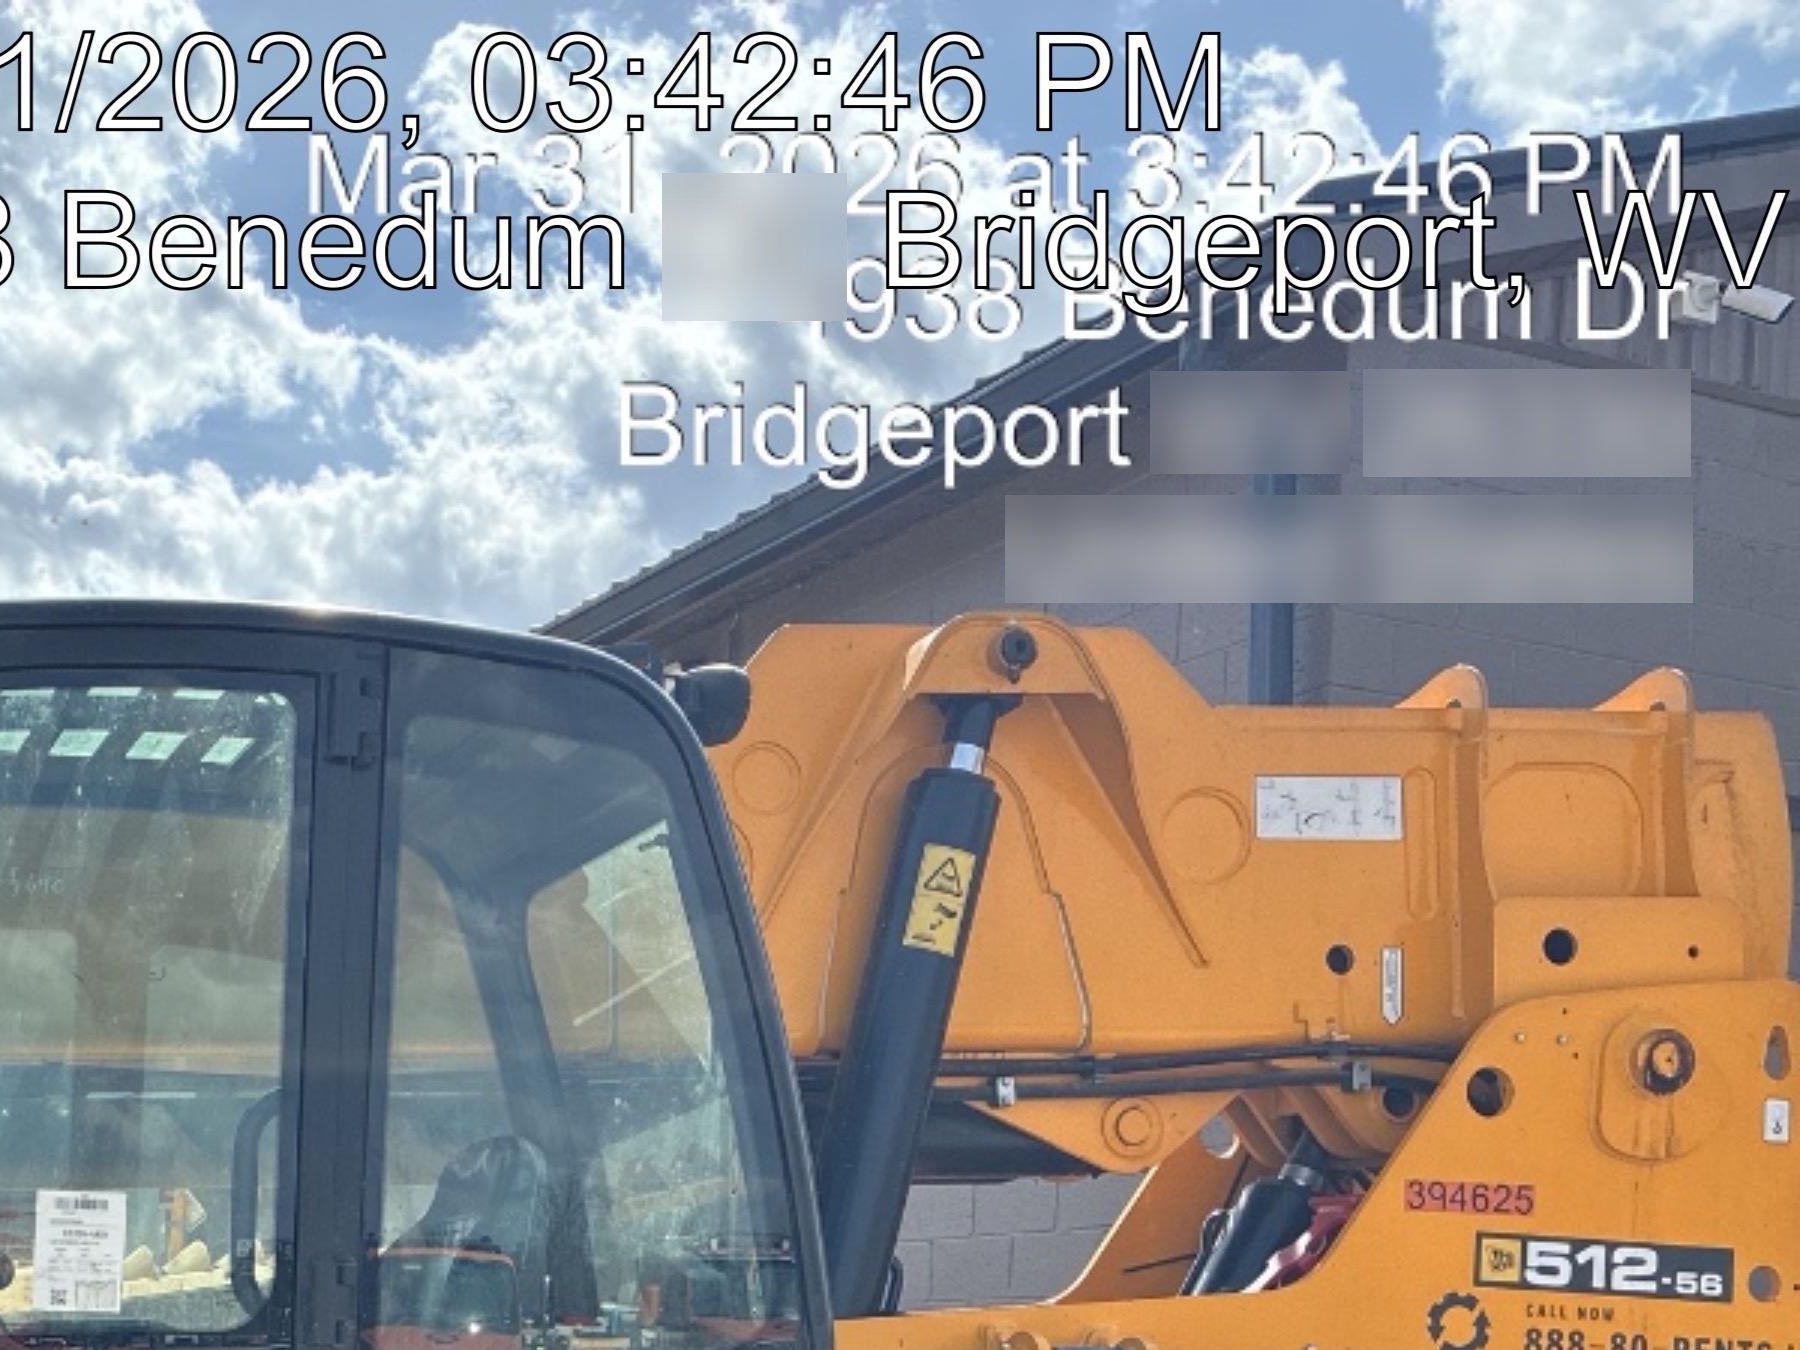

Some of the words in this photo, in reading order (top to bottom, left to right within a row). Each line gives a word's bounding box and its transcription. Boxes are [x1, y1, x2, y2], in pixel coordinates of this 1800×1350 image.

[1406, 1179, 1535, 1216] 394625
[1523, 1240, 1724, 1298] 512-56
[1526, 1303, 1567, 1320] CALL
[1577, 1306, 1615, 1322] NOW
